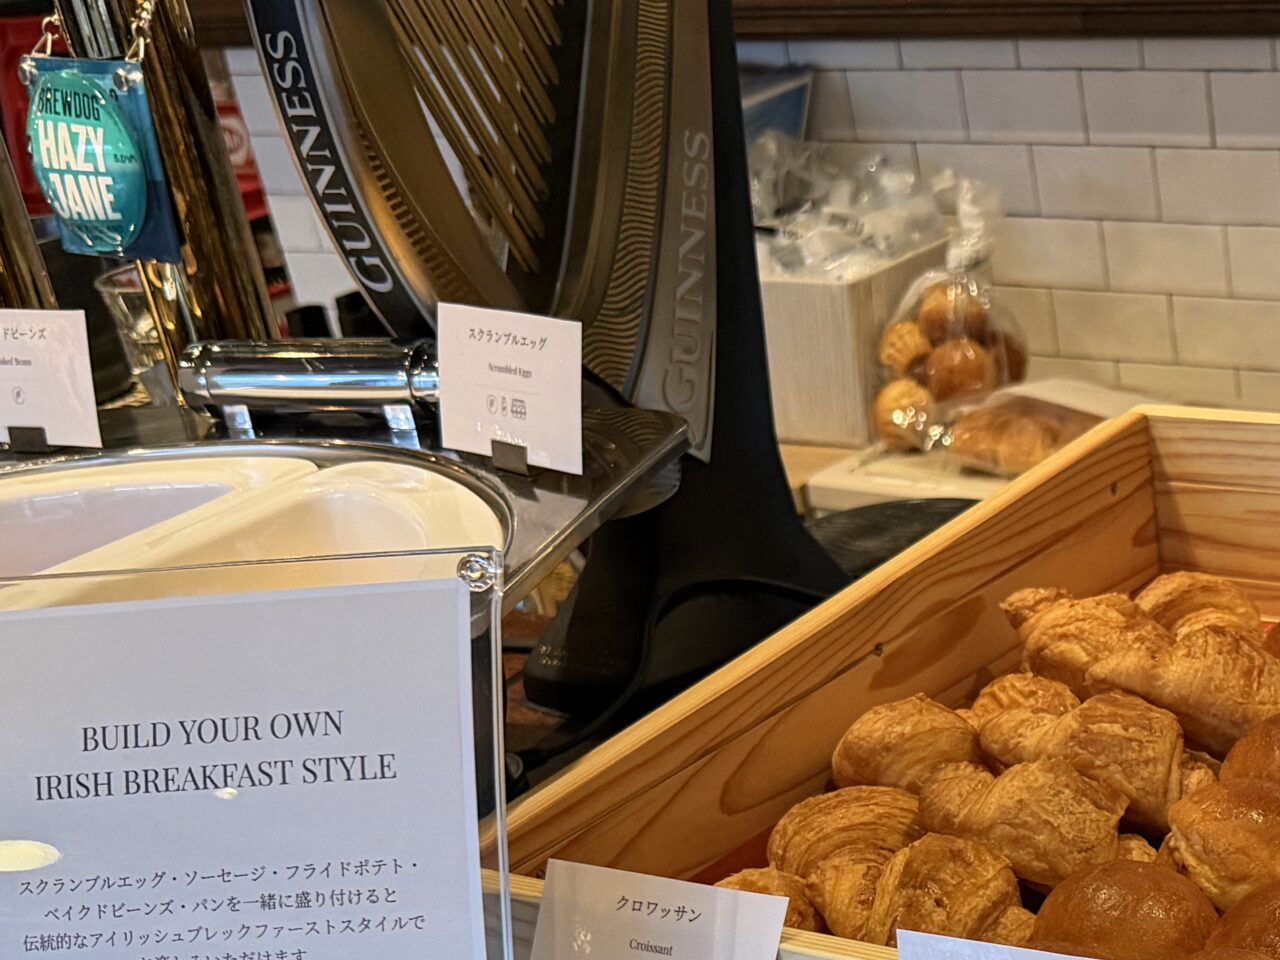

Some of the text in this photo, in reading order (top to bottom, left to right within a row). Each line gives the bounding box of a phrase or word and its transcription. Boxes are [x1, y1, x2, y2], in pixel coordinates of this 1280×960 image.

[38, 87, 101, 122] BREWDOG
[38, 119, 107, 173] HAZY
[265, 30, 394, 293] GUINNESS
[49, 173, 122, 221] JANE
[661, 130, 710, 415] GUINNESS
[468, 328, 548, 351] スクランブルエッグ
[81, 710, 345, 752] BUILD YOUR OWN
[34, 753, 398, 801] IRISH BREAKFAST STYLE
[615, 895, 703, 923] クロワッサン
[23, 915, 426, 953] 伝統的なアイリッシュブレックファーストスタイルで
[629, 938, 674, 957] Croissant
